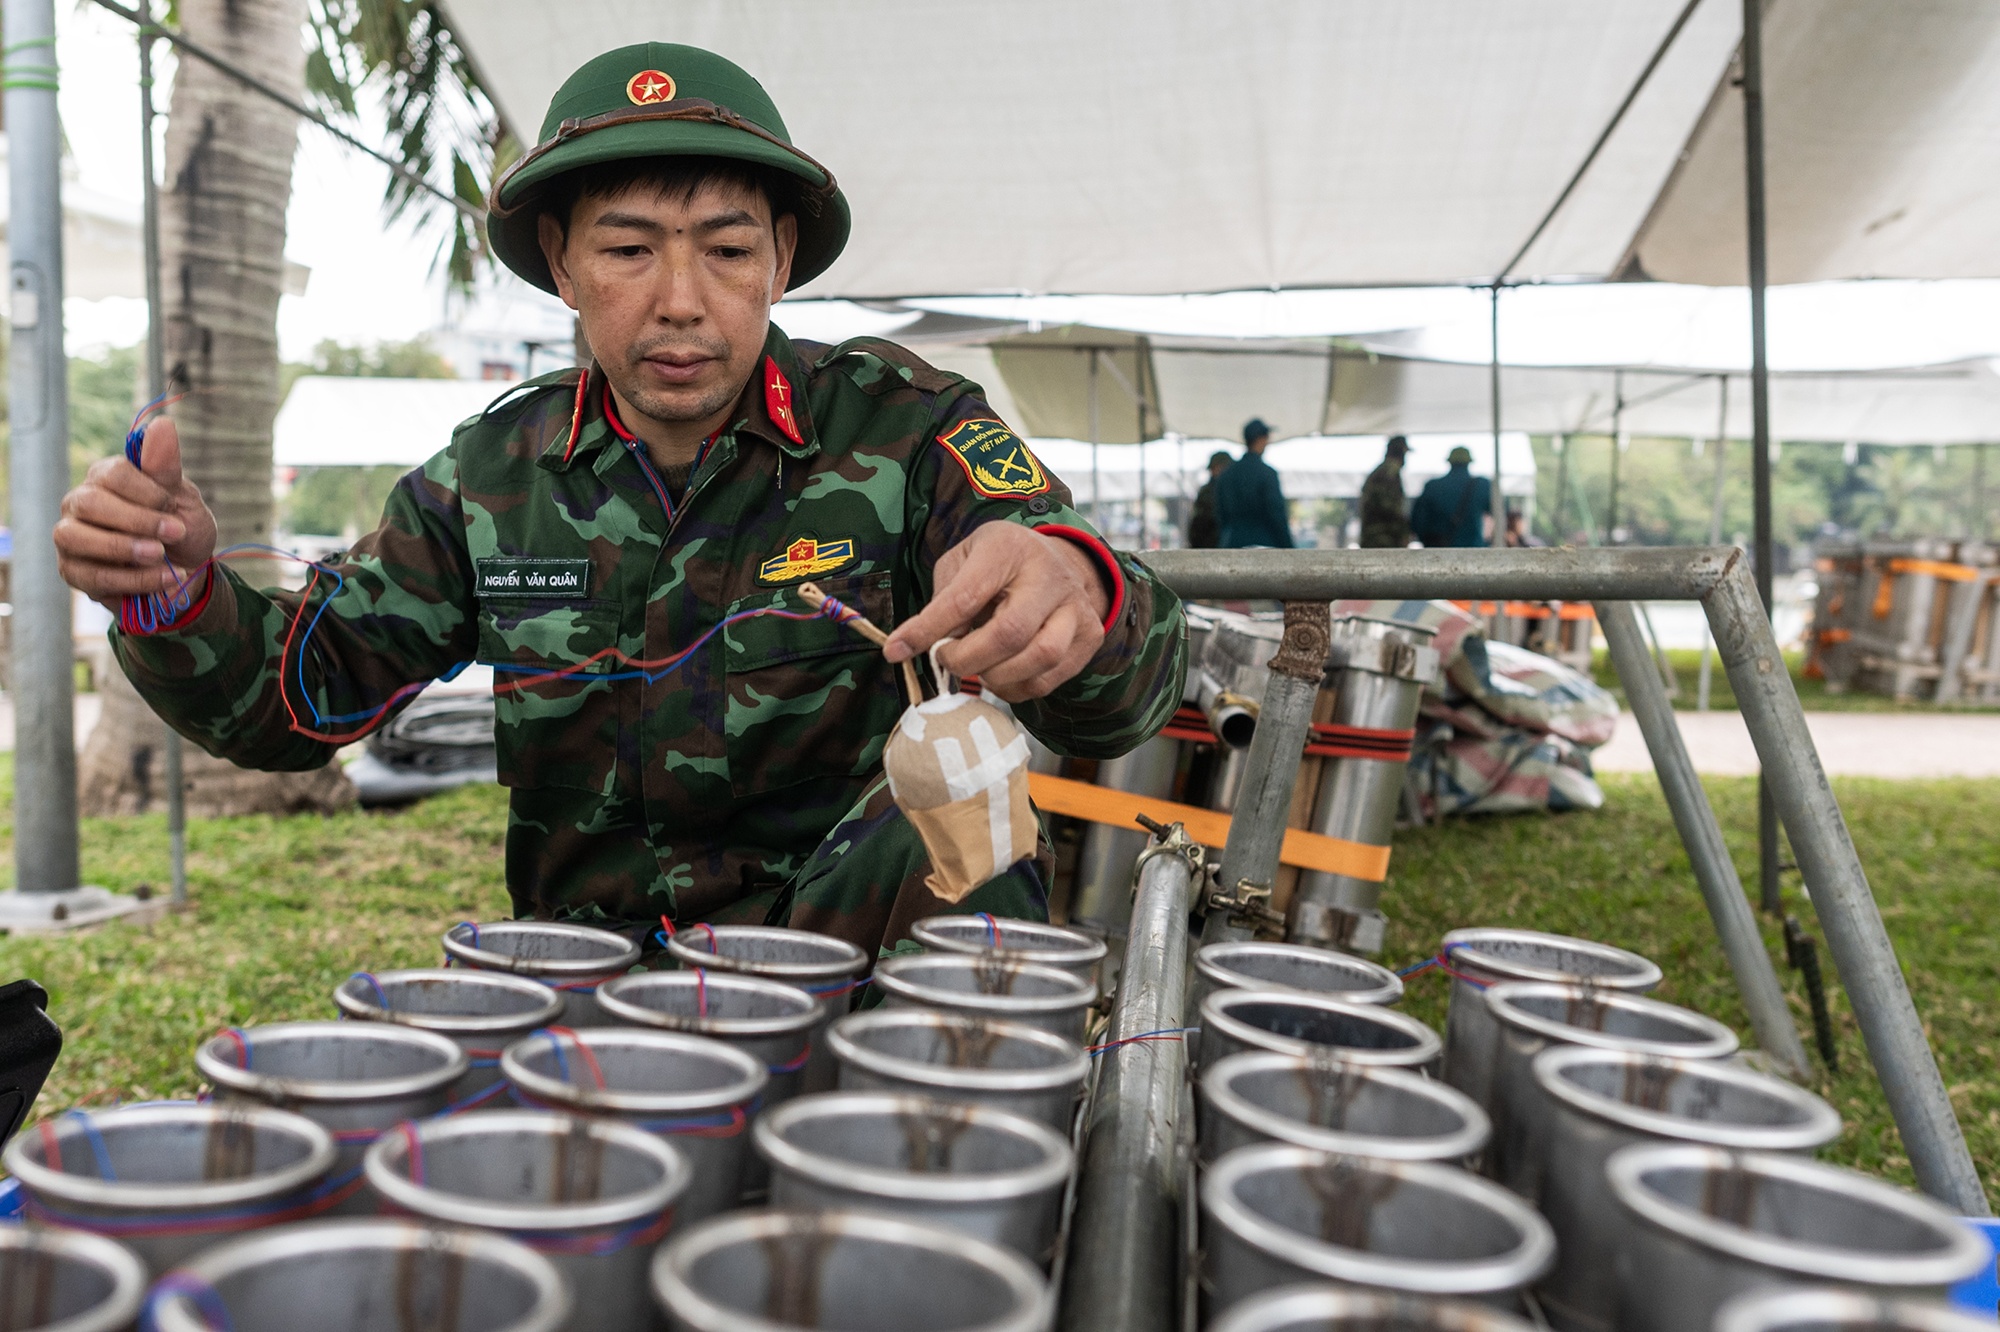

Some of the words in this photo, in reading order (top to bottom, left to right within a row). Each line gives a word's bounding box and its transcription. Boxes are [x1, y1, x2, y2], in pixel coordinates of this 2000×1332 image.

[959, 439, 977, 452] QUÂN
[979, 440, 994, 453] VIỆT
[994, 433, 1011, 446] NAM
[484, 569, 520, 587] NGUYỄN
[525, 571, 546, 587] VĂN
[549, 571, 578, 587] QUÂN
